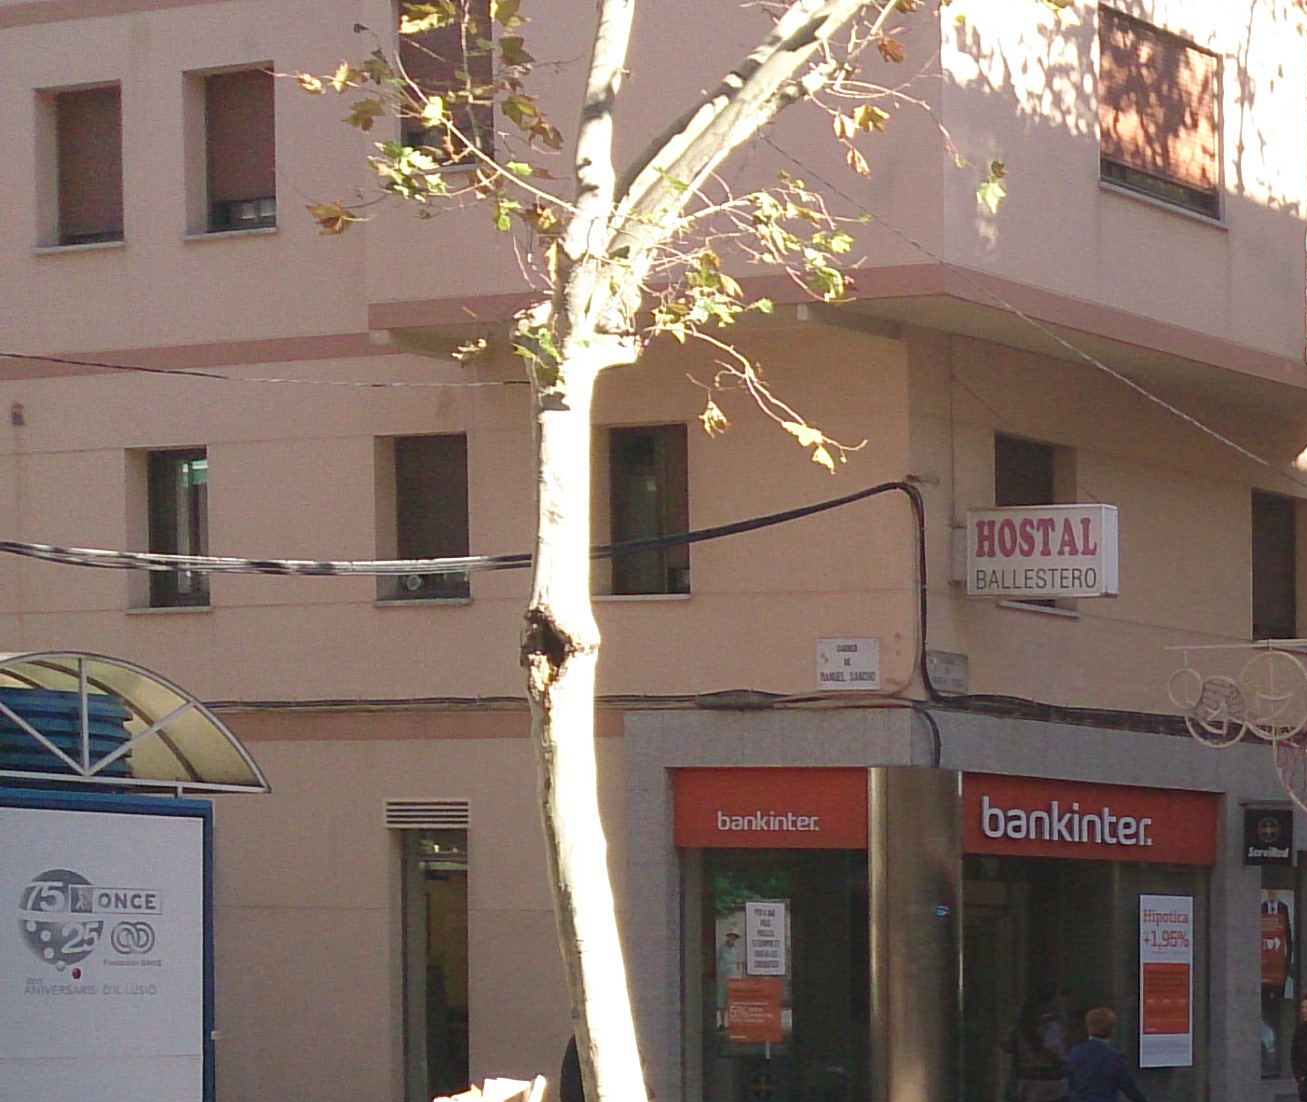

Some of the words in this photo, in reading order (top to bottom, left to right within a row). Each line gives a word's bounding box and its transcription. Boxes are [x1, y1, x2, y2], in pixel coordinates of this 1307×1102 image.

[974, 516, 1098, 558] HOSTAL
[975, 567, 1097, 591] BALLESTERO
[1247, 846, 1290, 858] ServiRed
[26, 881, 67, 912] 75
[97, 892, 158, 911] ONCE
[61, 922, 100, 954] 25
